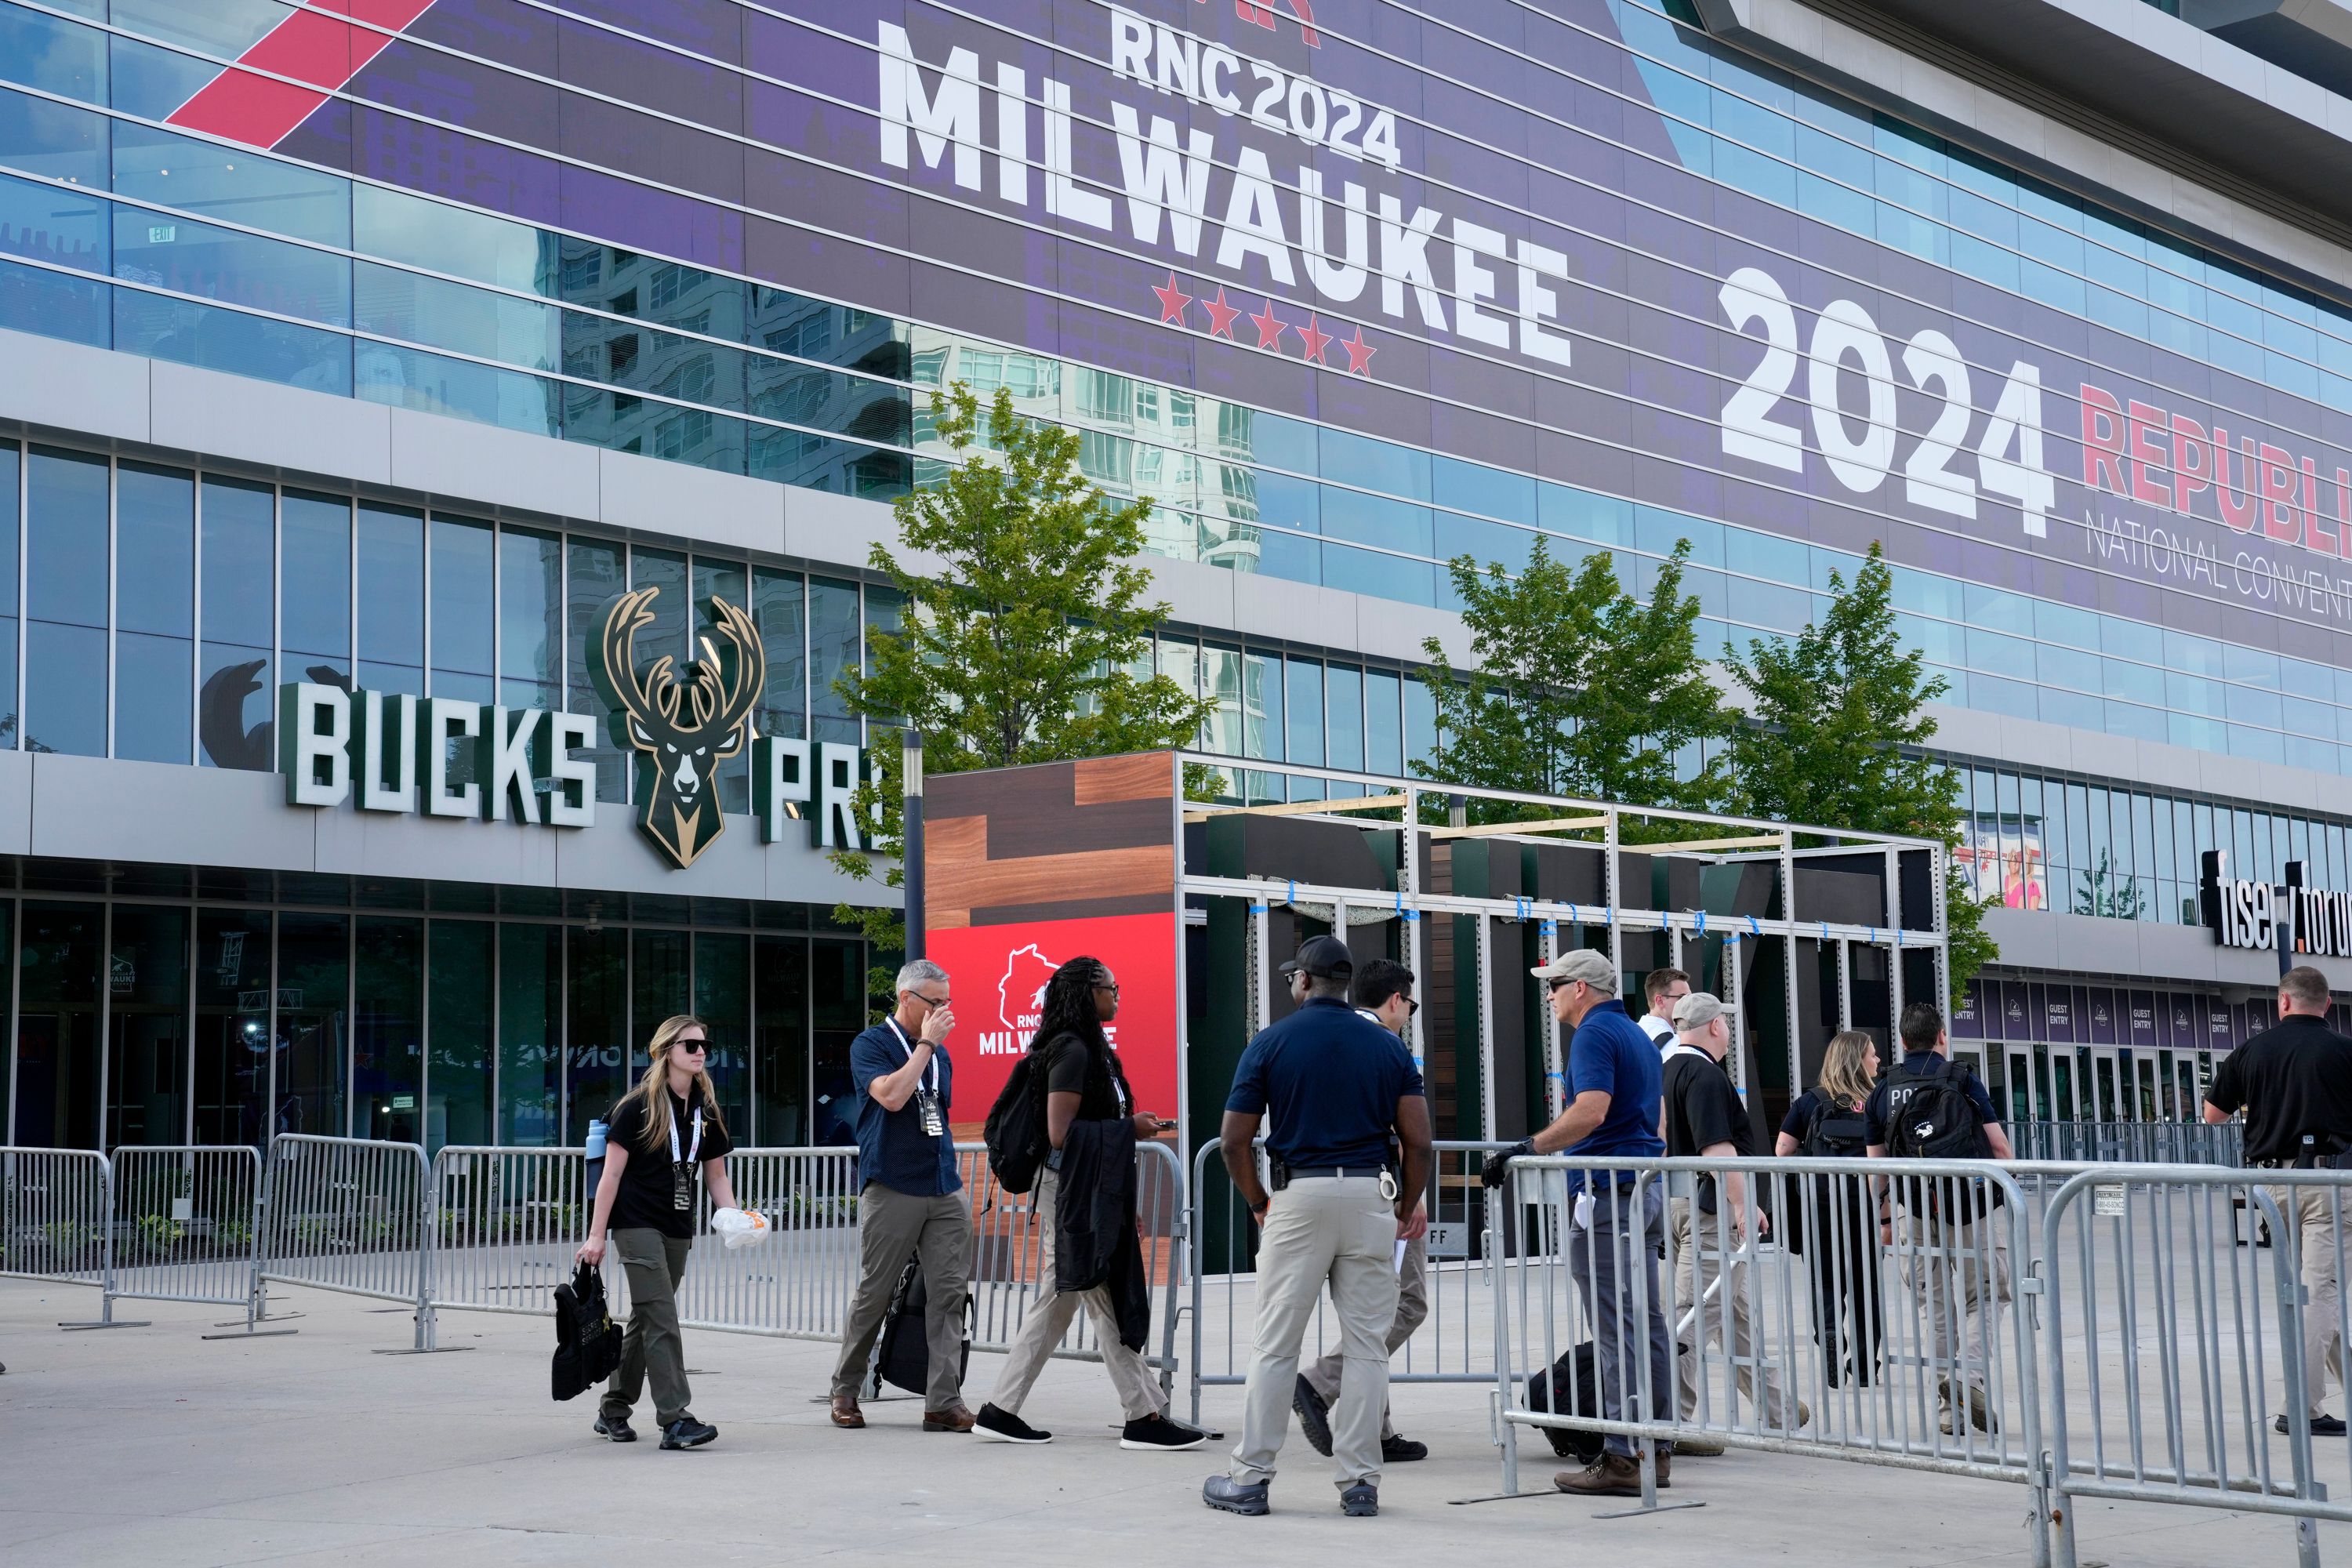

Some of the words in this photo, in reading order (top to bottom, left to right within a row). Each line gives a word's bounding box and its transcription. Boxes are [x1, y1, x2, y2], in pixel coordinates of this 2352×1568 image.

[1110, 5, 1242, 116] RNC
[1250, 60, 1402, 173] 2024
[878, 20, 1571, 367] MILWAUKEE
[154, 227, 170, 241] EXIT
[1718, 267, 2055, 539] 2024
[2080, 383, 2352, 563] REPUBLI
[2085, 509, 2227, 590] NATIONAL
[2234, 552, 2352, 621] CONVENT
[290, 682, 597, 827] BUCKS
[2299, 860, 2352, 956] foru
[2049, 1004, 2067, 1014] GUEST
[2133, 1009, 2151, 1018] GUEST
[1017, 1014, 1042, 1028] RNC
[2049, 1015, 2068, 1025] ENTRY
[2134, 1020, 2151, 1029] ENTRY
[2211, 1014, 2228, 1022] GUEST
[2212, 1024, 2229, 1033] ENTRY
[1430, 1229, 1447, 1244] FF
